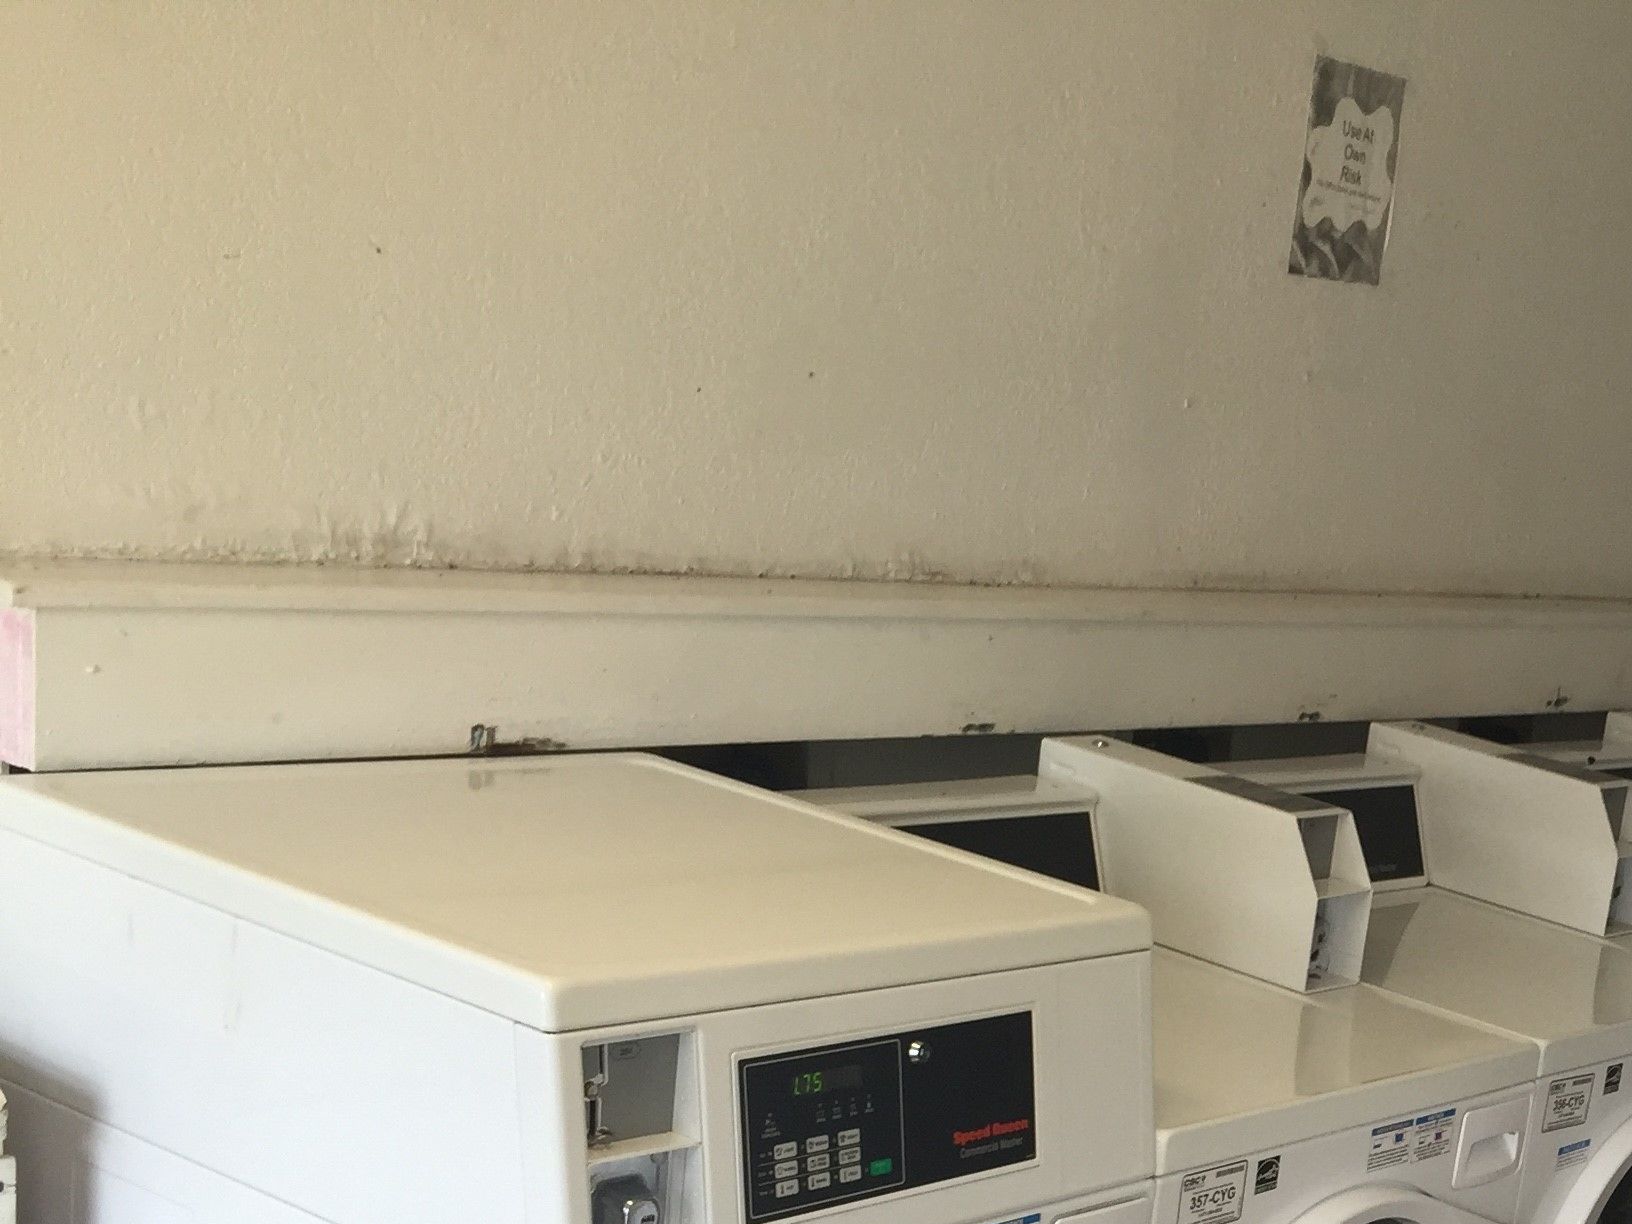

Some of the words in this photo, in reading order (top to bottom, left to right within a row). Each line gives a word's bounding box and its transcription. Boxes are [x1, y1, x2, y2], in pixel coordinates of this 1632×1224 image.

[1343, 120, 1362, 140] Use
[1344, 143, 1366, 165] Own
[1340, 165, 1362, 185] Risk
[953, 1124, 991, 1148] Speed
[993, 1119, 1029, 1137] Queen
[1189, 1186, 1237, 1211] 357-CYG
